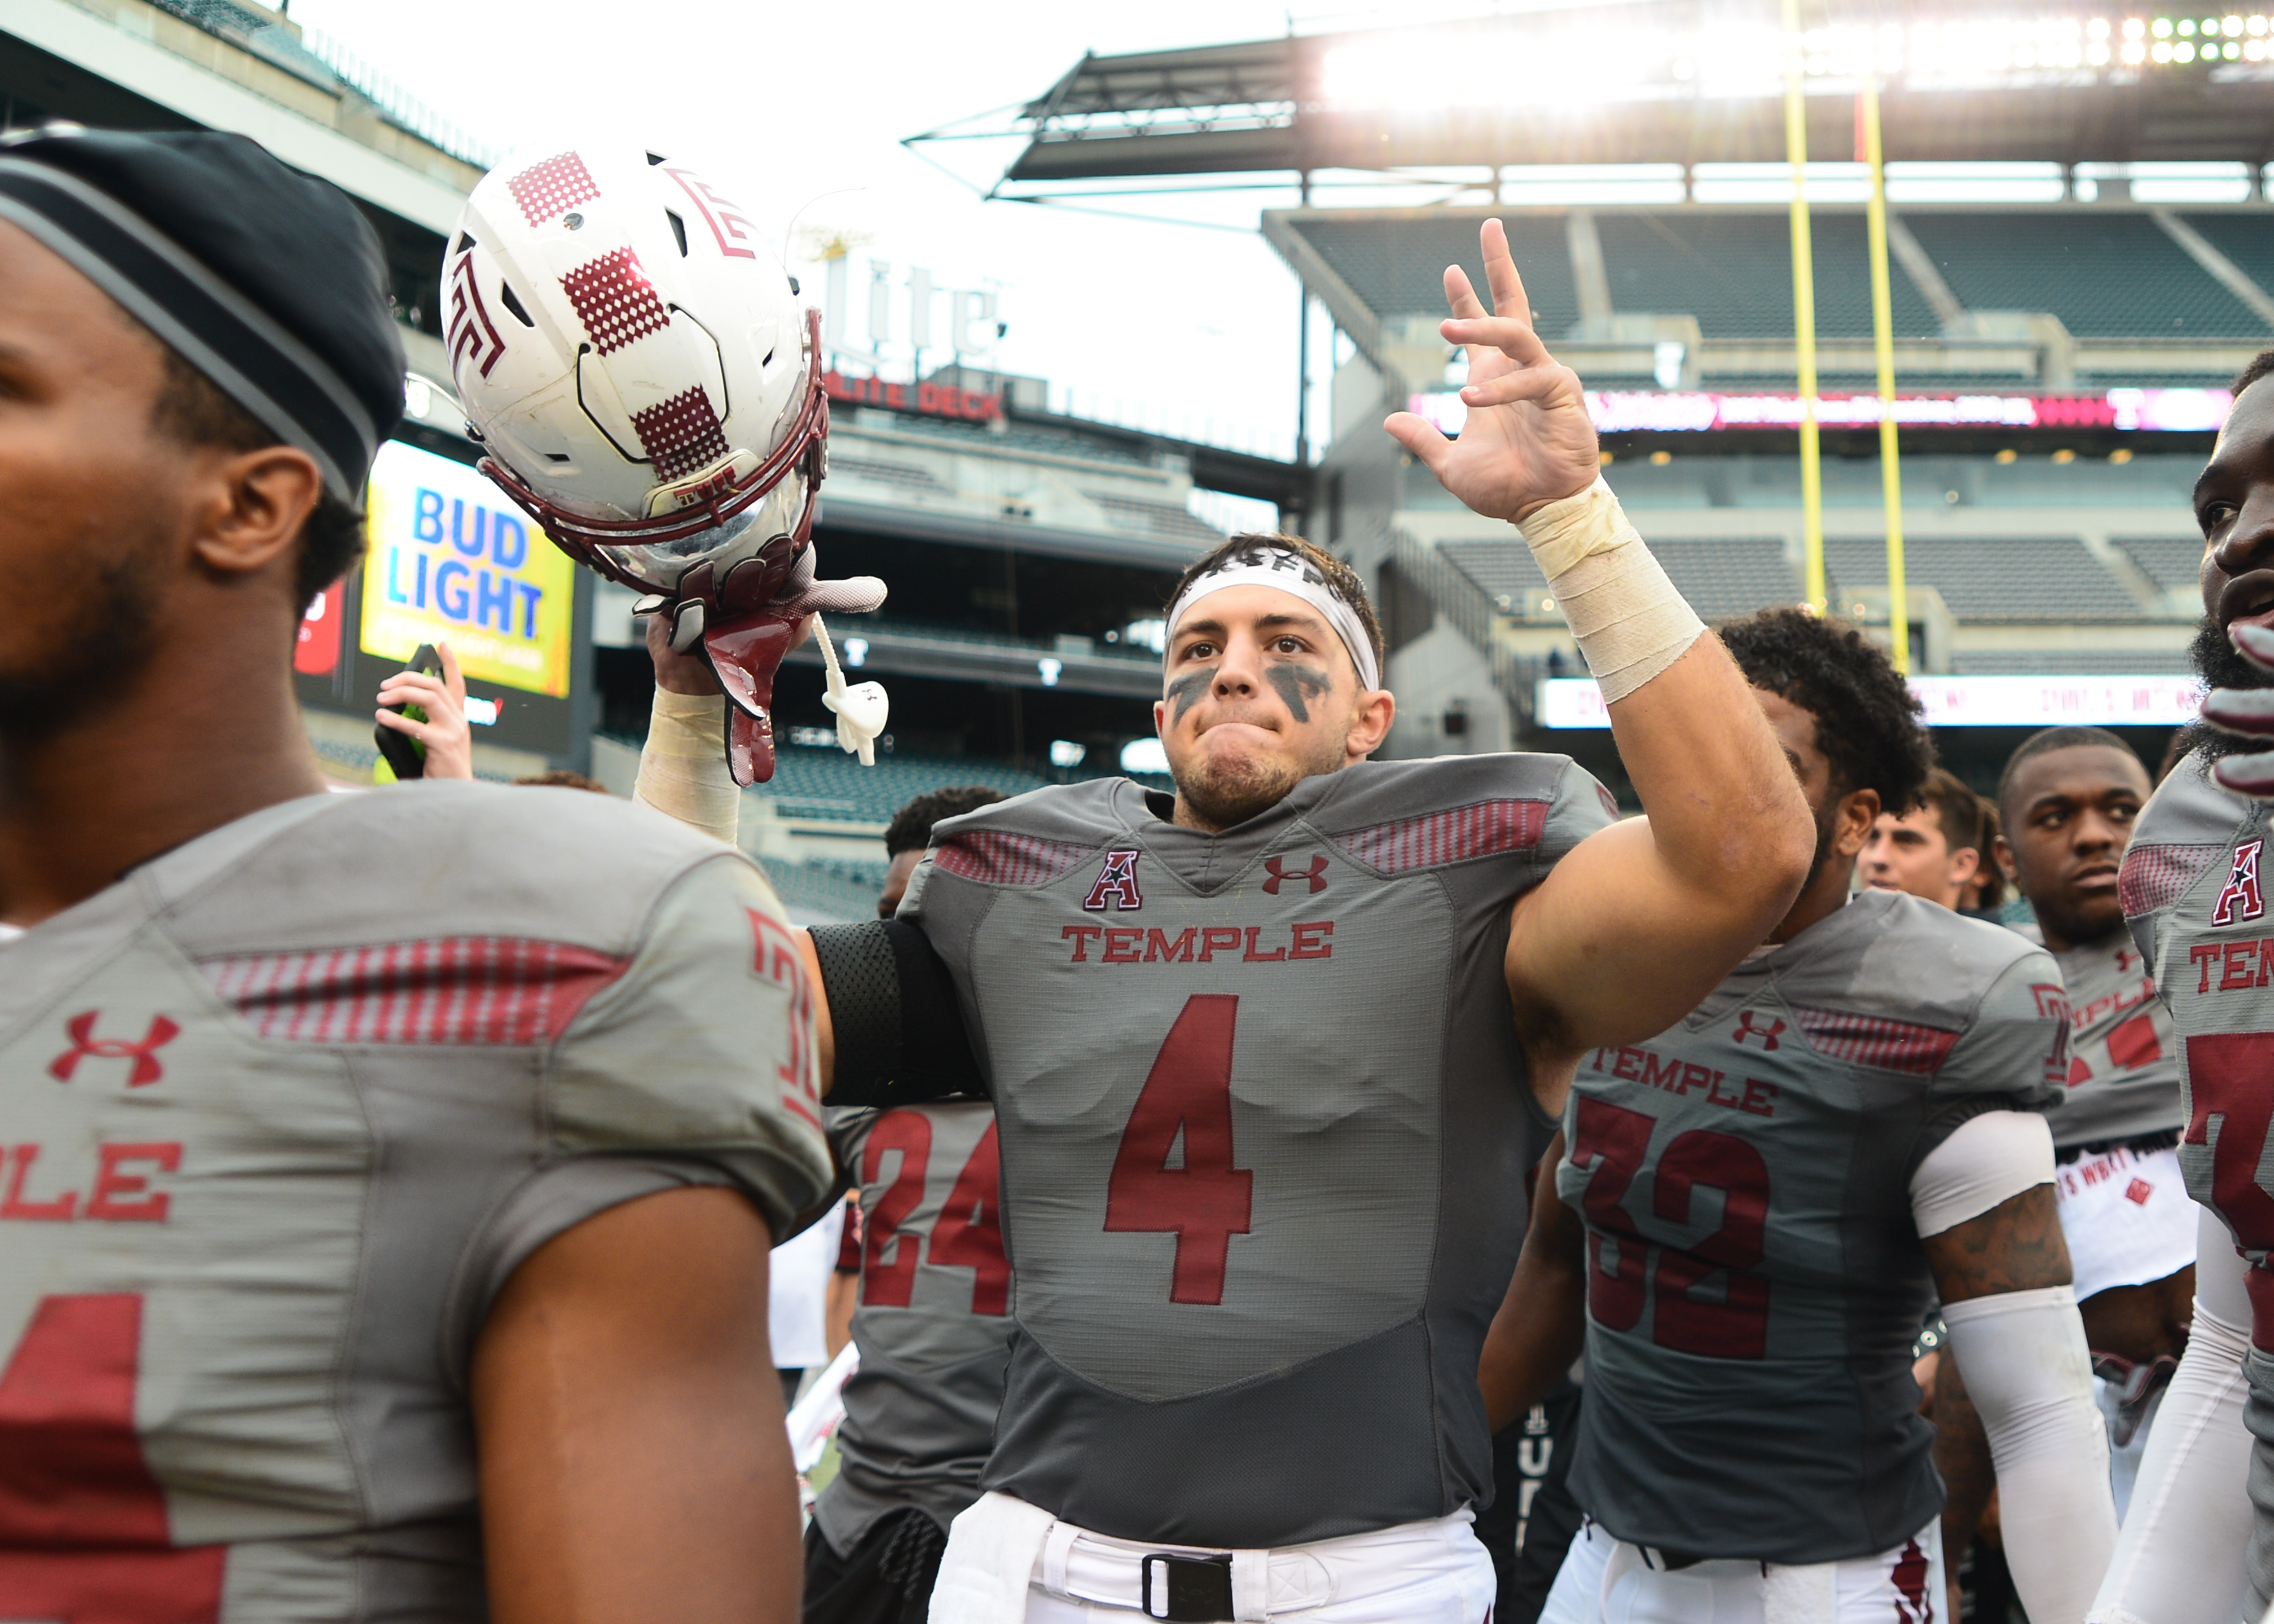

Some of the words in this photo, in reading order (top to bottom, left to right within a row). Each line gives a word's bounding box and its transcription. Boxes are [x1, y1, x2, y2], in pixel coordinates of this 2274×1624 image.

[917, 382, 1003, 419] DECK
[412, 486, 528, 570] BUD
[386, 544, 542, 640] LIGHT
[1061, 920, 1335, 963] TEMPLE
[1592, 1045, 1780, 1117] TEMPLE
[0, 1141, 183, 1222] LE
[1103, 993, 1254, 1305] 4
[861, 1110, 1011, 1316] 24
[1570, 1095, 1771, 1360] 32
